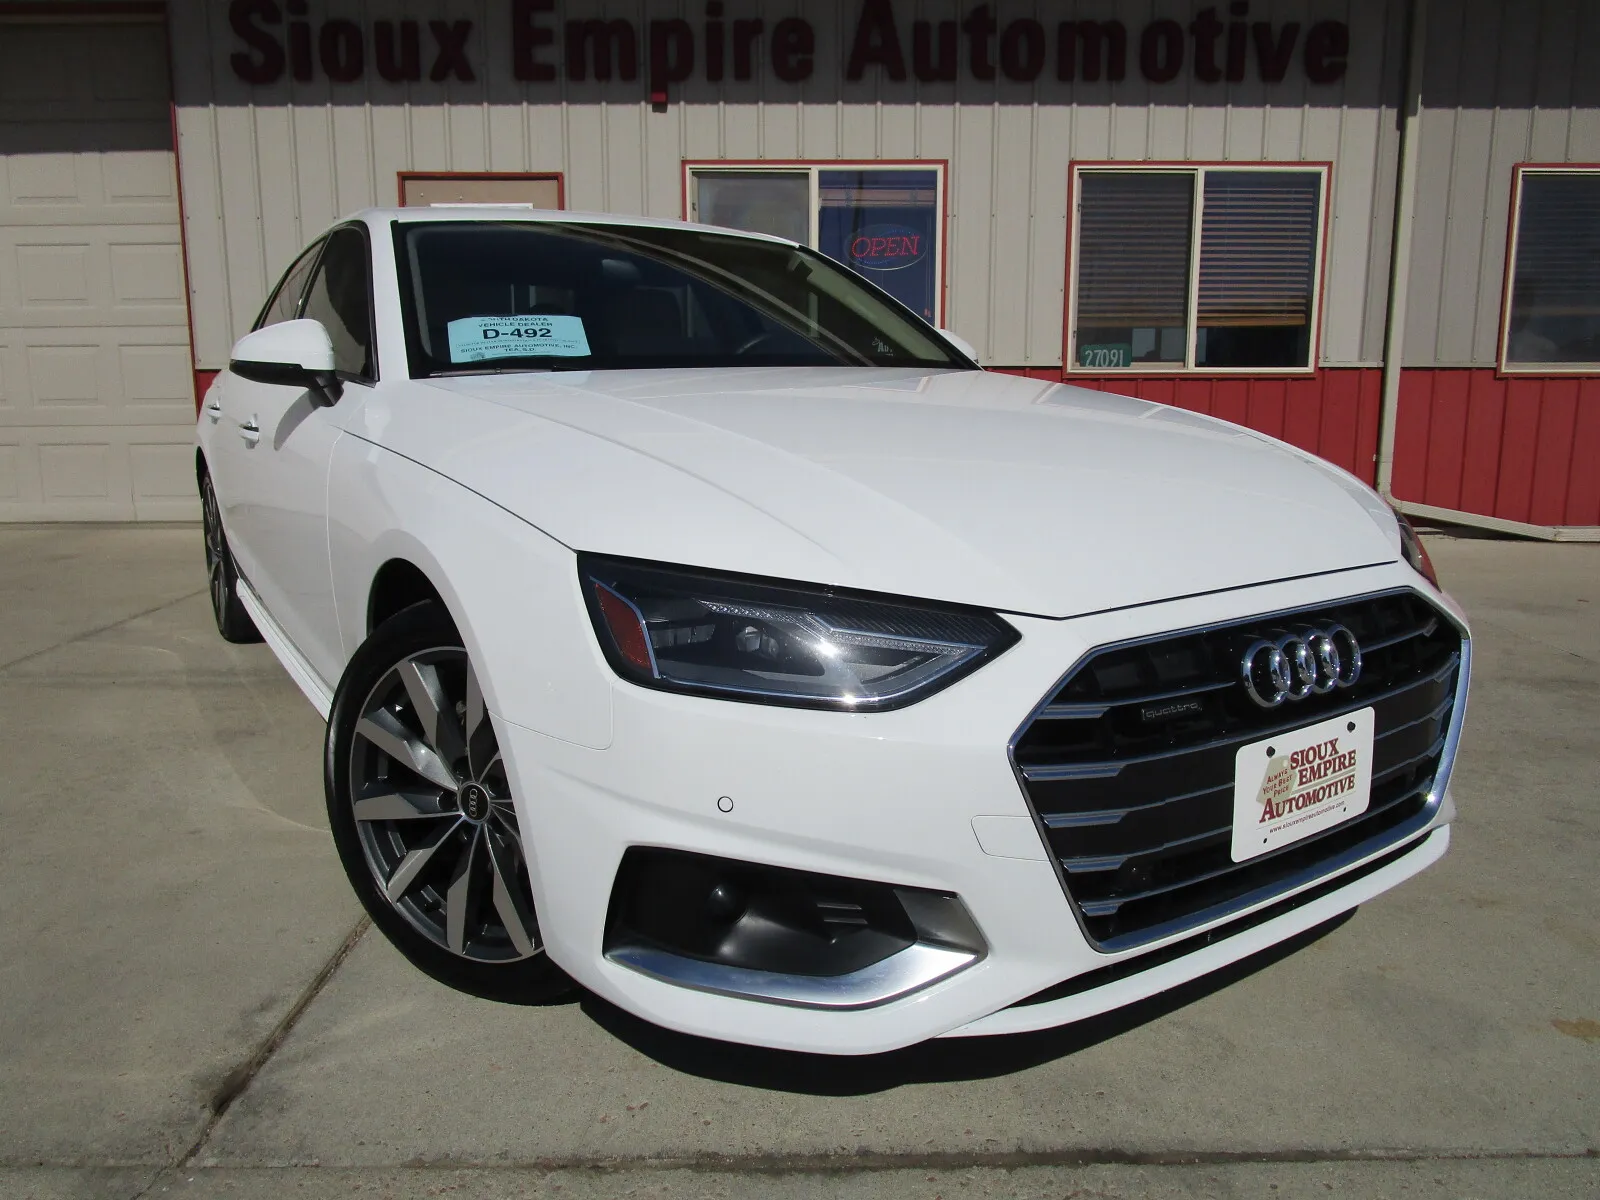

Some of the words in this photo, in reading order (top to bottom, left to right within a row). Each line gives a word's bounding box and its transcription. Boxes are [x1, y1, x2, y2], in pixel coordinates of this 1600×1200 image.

[229, 0, 477, 84] Sioux
[512, 0, 815, 104] Empire
[846, 0, 1350, 84] Automotive
[851, 235, 921, 258] OPEN
[482, 328, 553, 340] D-492
[1084, 349, 1124, 367] 27091
[1145, 702, 1199, 719] quattro
[1290, 737, 1339, 770] SIOUX
[1297, 749, 1356, 787] EMPIRE
[1259, 772, 1356, 824] AUTOMOTIVE
[1269, 800, 1345, 834] www.siouxempireautomotive.com
